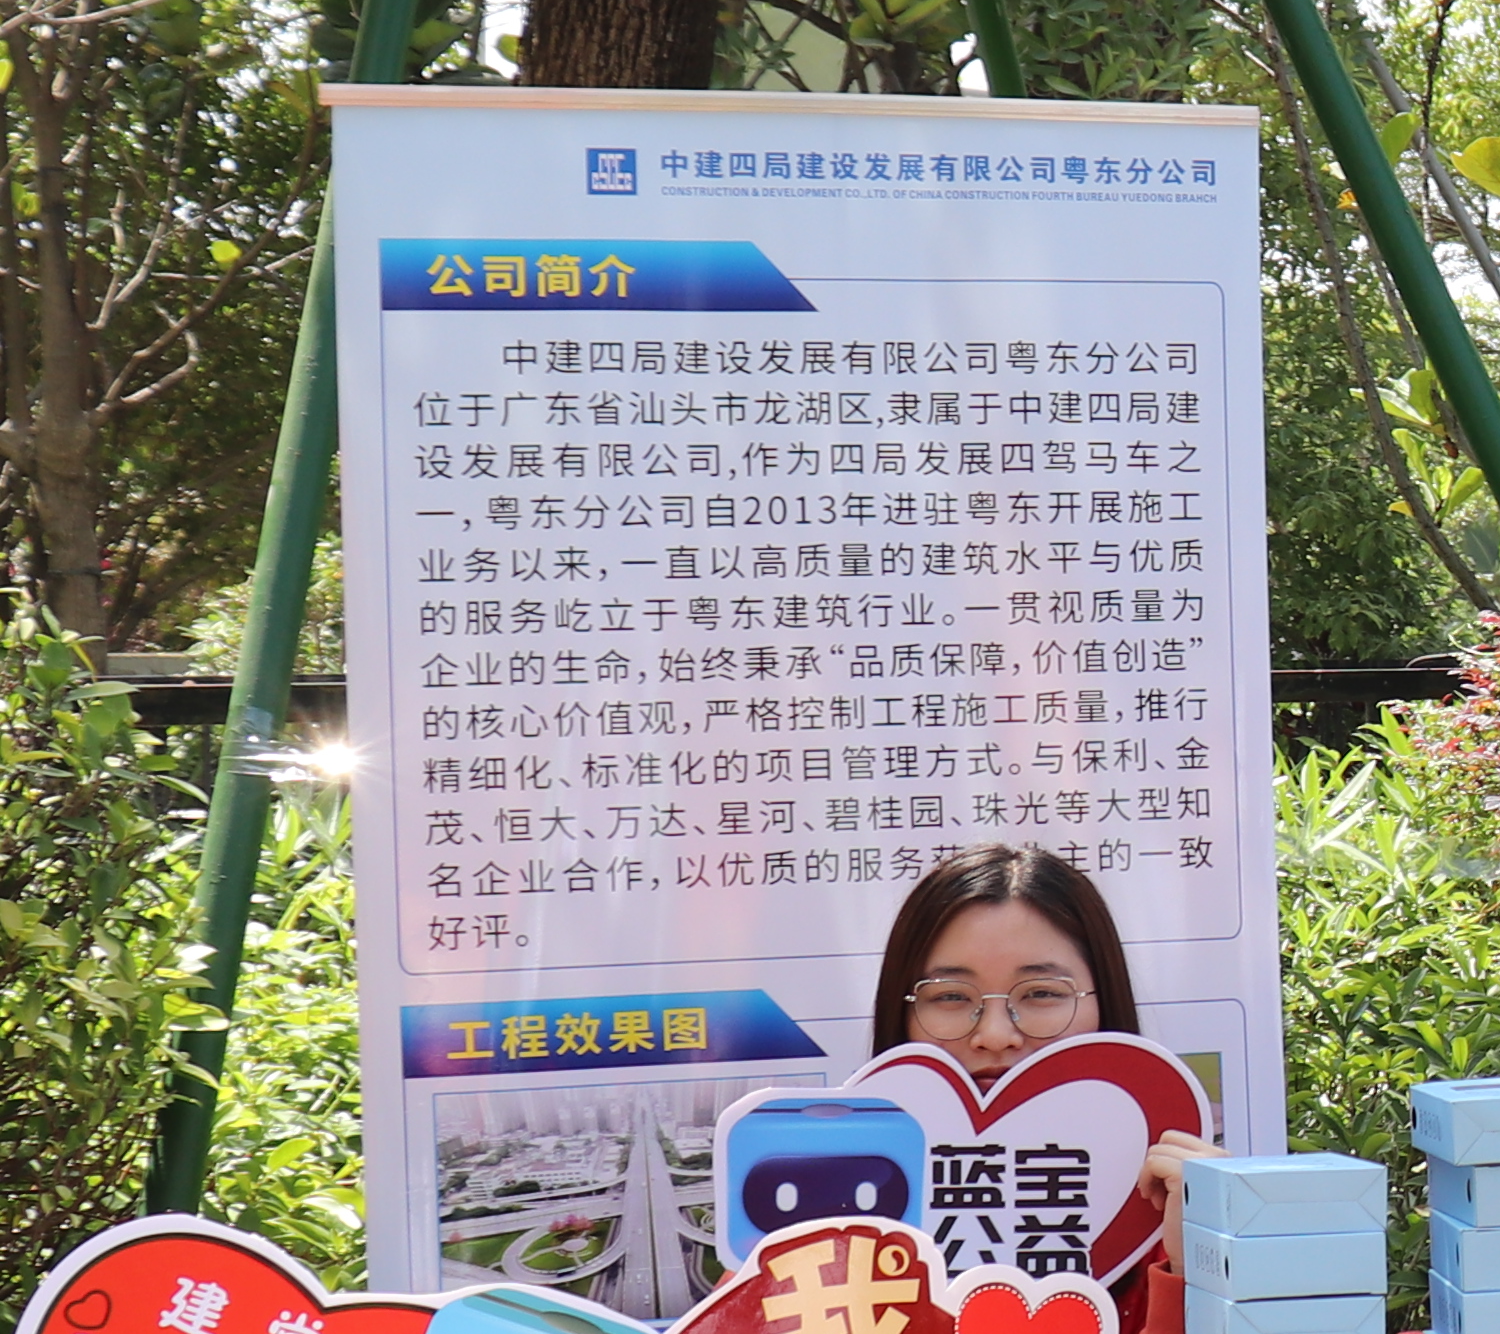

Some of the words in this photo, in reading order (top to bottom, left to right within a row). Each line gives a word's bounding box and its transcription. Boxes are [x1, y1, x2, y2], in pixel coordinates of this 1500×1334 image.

[659, 149, 1217, 187] 中建四局建设发展有限公司粤东分公司
[660, 185, 750, 198] CONSTRUCTION
[762, 186, 843, 199] DEVELOPMENT
[892, 188, 907, 200] OF
[908, 188, 943, 201] CHINA
[944, 189, 1030, 202] CONSTRUCTION
[1031, 190, 1075, 203] FOURTH
[1075, 191, 1120, 203] BUREAU
[1121, 192, 1174, 204] YUEDONG
[426, 252, 637, 299] 公司简介
[501, 338, 1198, 375] 中建四局建设发展有限公司粤东分公司
[418, 588, 1204, 636] 的服务屹立于粤东建筑行业。一贯视质量为
[427, 913, 530, 952] 好评。
[446, 1006, 710, 1061] 工程效果图
[929, 1143, 1092, 1210] 蓝宝
[930, 1214, 1092, 1278] 公益
